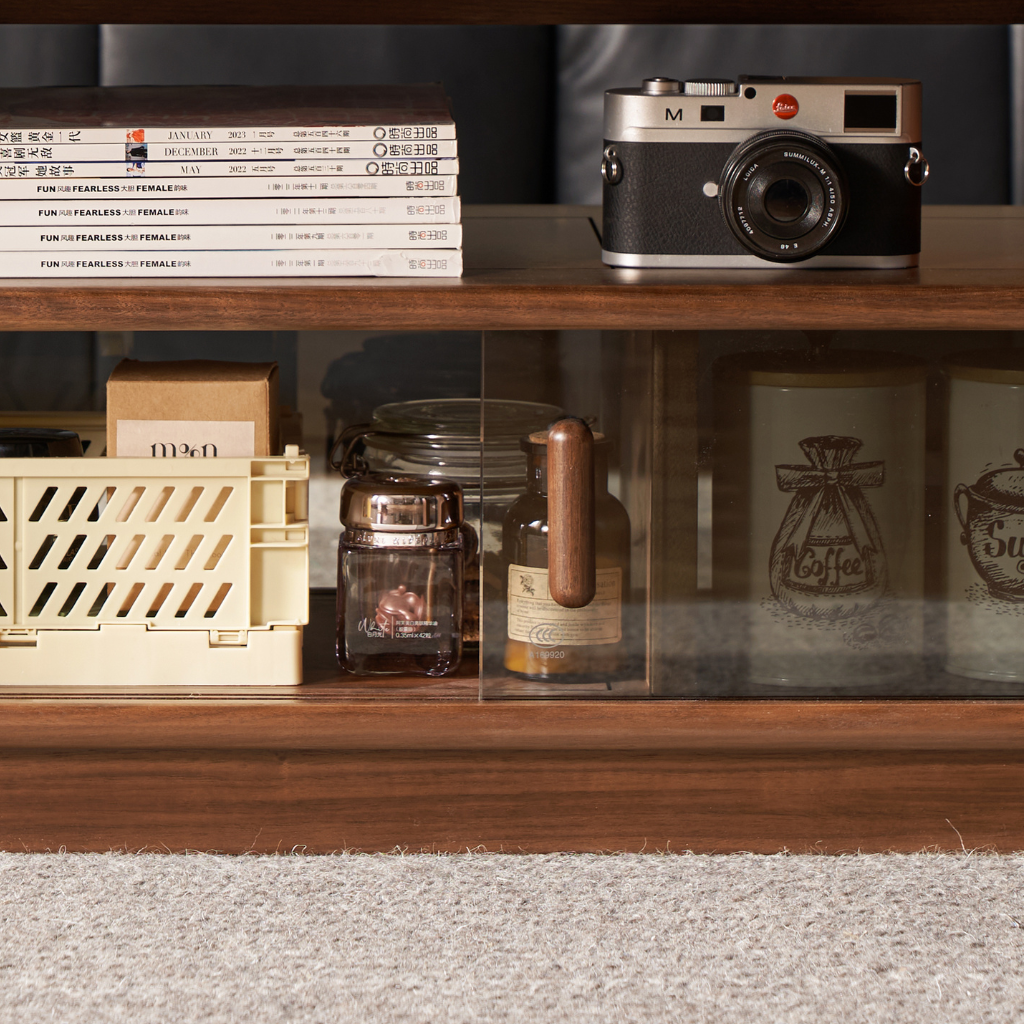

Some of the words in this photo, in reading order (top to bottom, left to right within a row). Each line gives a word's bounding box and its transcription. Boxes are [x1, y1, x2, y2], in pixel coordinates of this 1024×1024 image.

[666, 108, 682, 121] M
[168, 130, 211, 140] JANUARY
[228, 131, 247, 139] 2023
[165, 147, 219, 157] DECEMBER
[229, 147, 247, 156] 2022
[181, 165, 200, 174] MAY
[229, 165, 247, 174] 2022
[37, 185, 56, 193] FUN
[73, 184, 120, 193] FEARLESS
[137, 184, 174, 192] FEMALE
[39, 209, 58, 217] FUN
[74, 208, 122, 217] FEARLESS
[138, 208, 175, 216] FEMALE
[41, 234, 60, 242] FUN
[76, 233, 124, 242] FEARLESS
[140, 233, 177, 242] FEMALE
[41, 260, 60, 268] FUN
[77, 260, 124, 268] FEARLESS
[140, 260, 177, 268] FEMALE
[794, 547, 864, 586] Coffee
